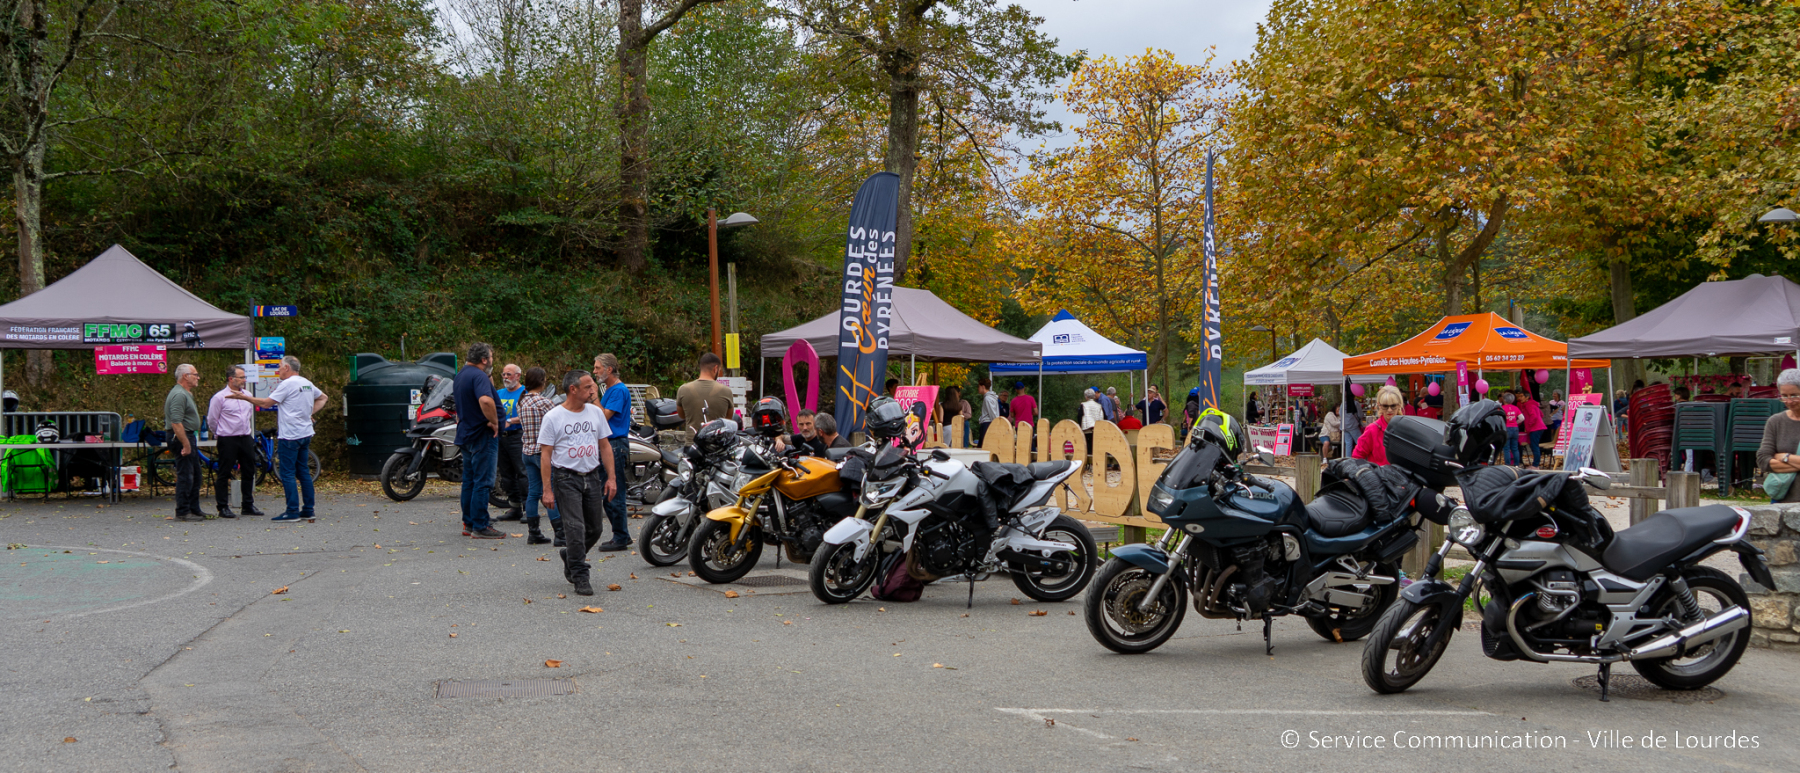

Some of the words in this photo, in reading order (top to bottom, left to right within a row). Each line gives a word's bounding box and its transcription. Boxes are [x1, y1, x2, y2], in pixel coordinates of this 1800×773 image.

[864, 228, 879, 264] des
[841, 226, 866, 348] LOURDES
[10, 325, 47, 333] FÉDÉRATION
[84, 323, 143, 339] FFMC
[148, 324, 171, 338] 65
[98, 353, 129, 361] MOTARDS
[139, 352, 164, 361] COLÈRE
[1369, 358, 1389, 367] Comité
[1389, 357, 1399, 366] des
[1399, 354, 1447, 366] Hautes-Pyrénées
[895, 389, 920, 398] OCTOBRE
[564, 420, 596, 435] COOL
